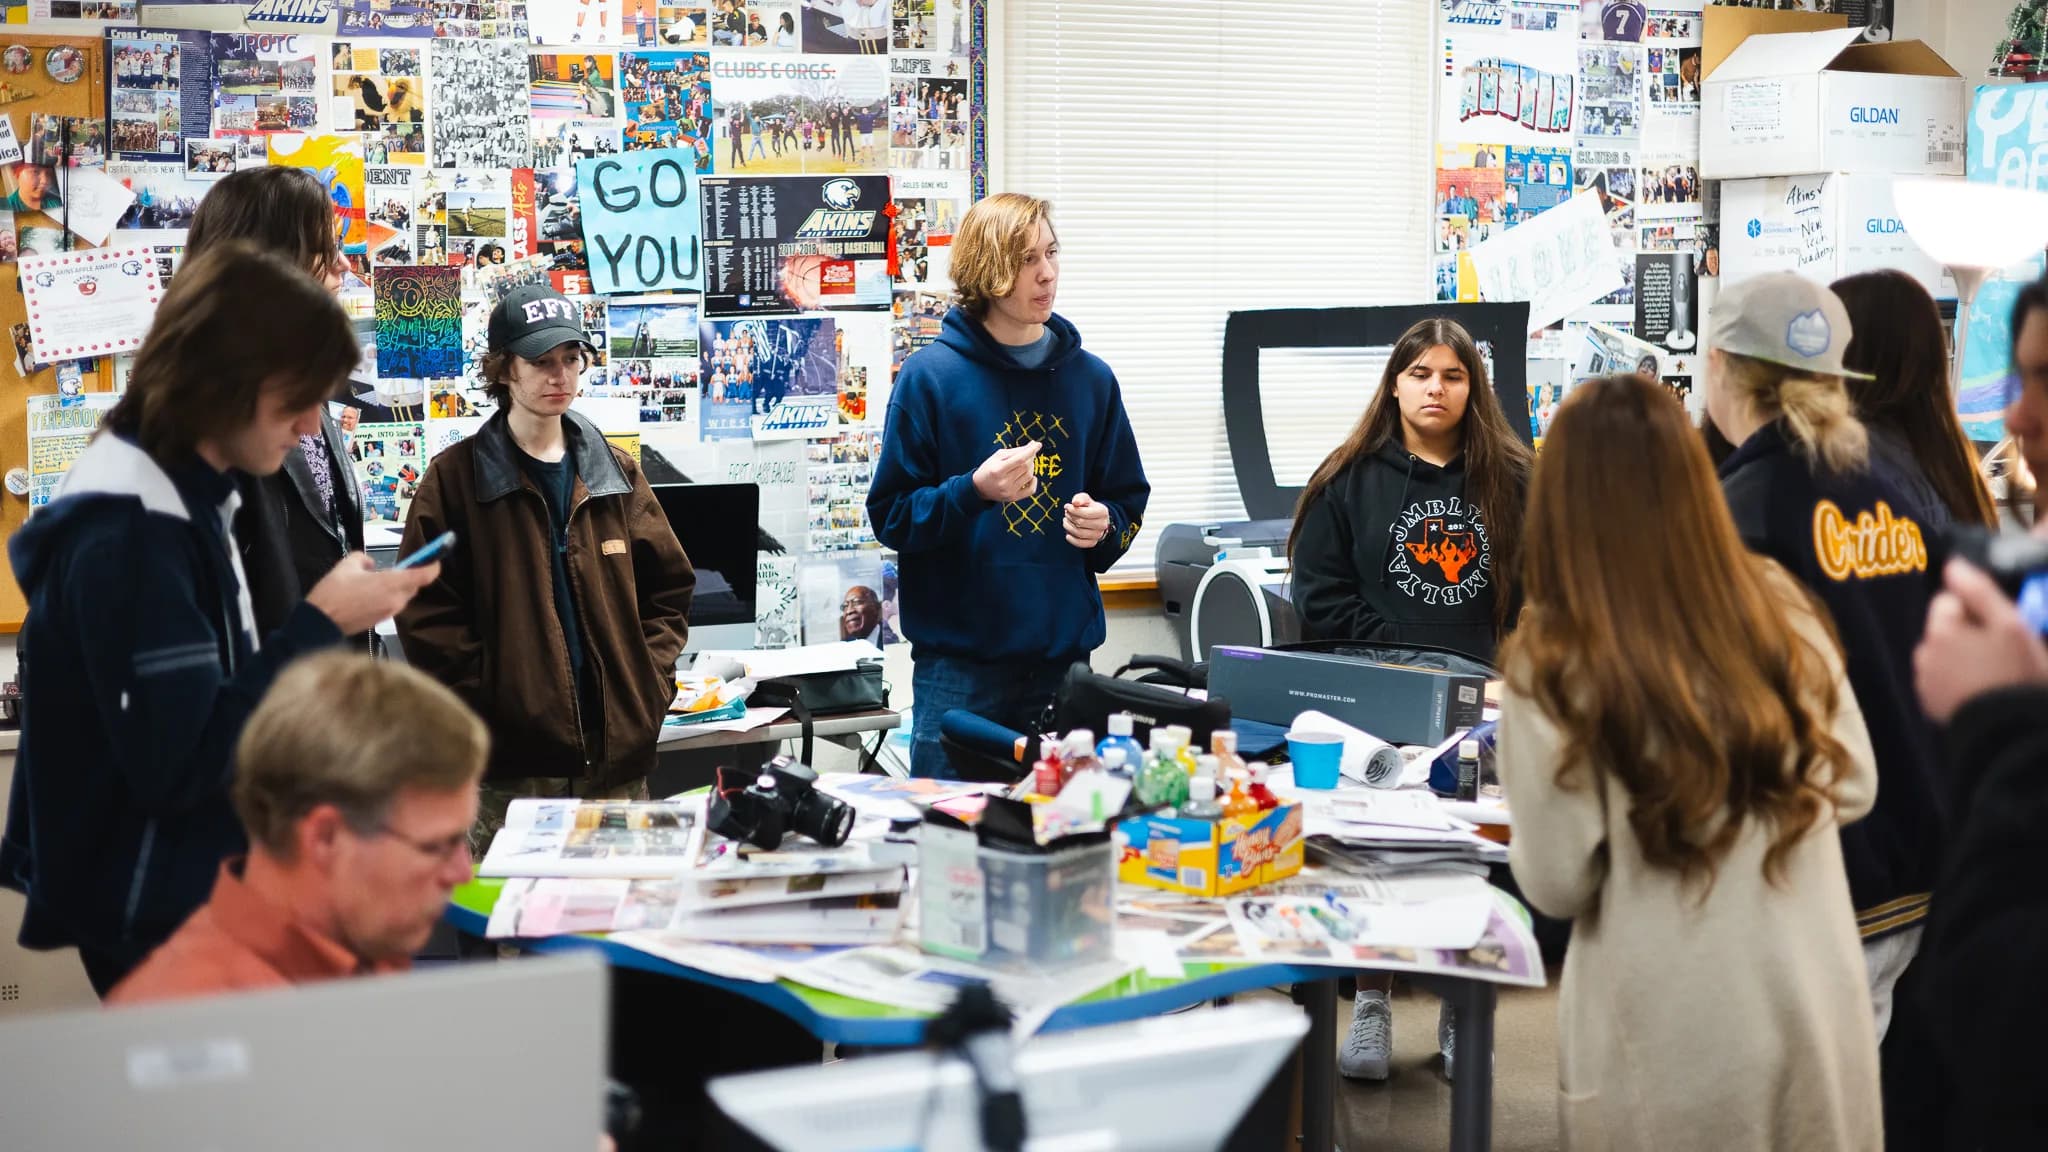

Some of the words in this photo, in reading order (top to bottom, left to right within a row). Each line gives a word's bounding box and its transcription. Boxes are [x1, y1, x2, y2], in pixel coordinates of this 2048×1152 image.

[250, 0, 331, 17] AKINS
[1451, 2, 1505, 20] AKINS
[1615, 10, 1630, 34] 7
[111, 29, 138, 40] Cross
[140, 29, 179, 41] Country
[234, 33, 299, 54] JROTC
[713, 61, 767, 79] CLUBS
[770, 62, 783, 79] &
[890, 58, 931, 74] LIFE
[1849, 106, 1899, 124] GILDAN
[1576, 152, 1619, 165] CLUBS
[593, 156, 687, 214] GO
[1786, 184, 1816, 206] Akins
[800, 209, 875, 231] AKINS
[1866, 218, 1908, 233] GILDA
[595, 233, 698, 288] YOU
[563, 275, 580, 294] 5
[763, 404, 833, 424] AKINS
[1033, 453, 1063, 479] IFE
[1813, 499, 1927, 581] Crider
[1288, 689, 1356, 703] WWW.PROMASTER.COM
